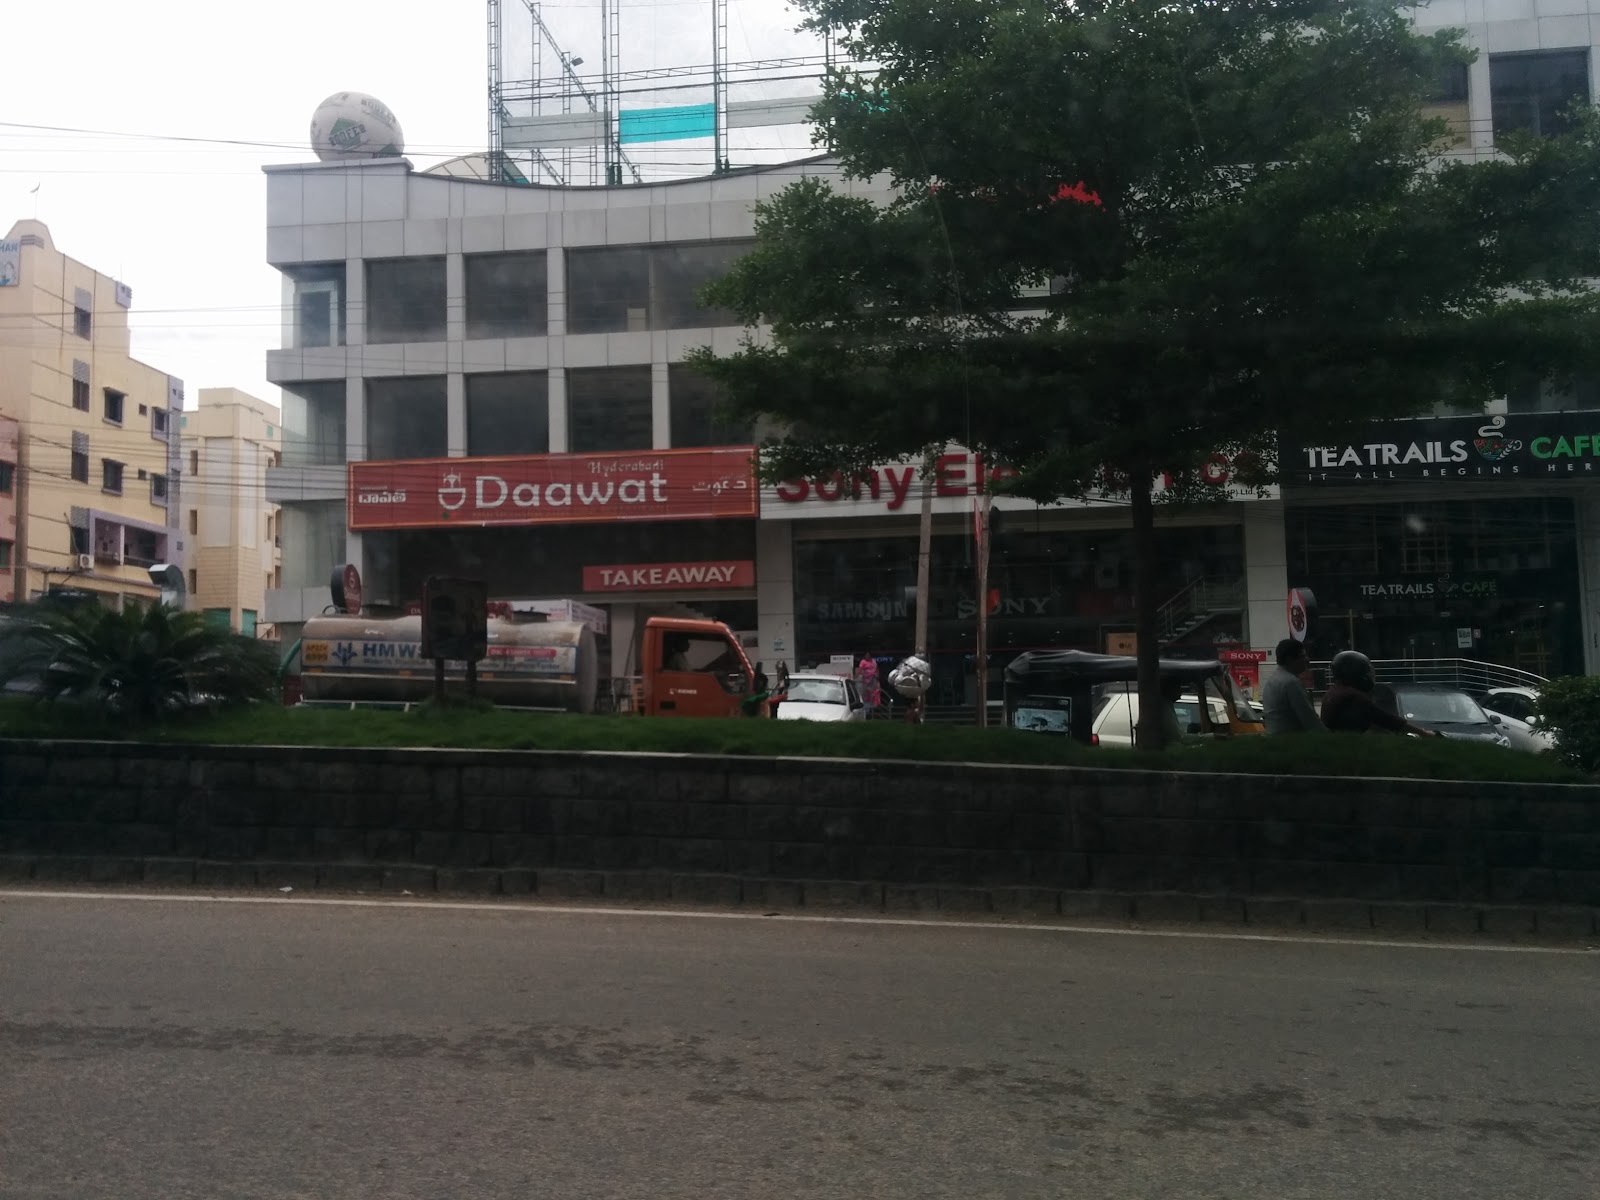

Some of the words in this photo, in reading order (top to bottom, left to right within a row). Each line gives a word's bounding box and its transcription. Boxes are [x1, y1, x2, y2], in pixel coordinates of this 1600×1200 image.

[587, 460, 664, 477] Hyderabadi
[1308, 473, 1327, 481] IT
[1354, 470, 1396, 479] ALL
[1423, 465, 1519, 477] BEGINS
[475, 472, 668, 509] Daawat
[600, 566, 736, 587] TAKEAWAY
[816, 601, 907, 619] SAMSUN
[363, 643, 422, 657] HMW
[1230, 652, 1262, 660] SONY
